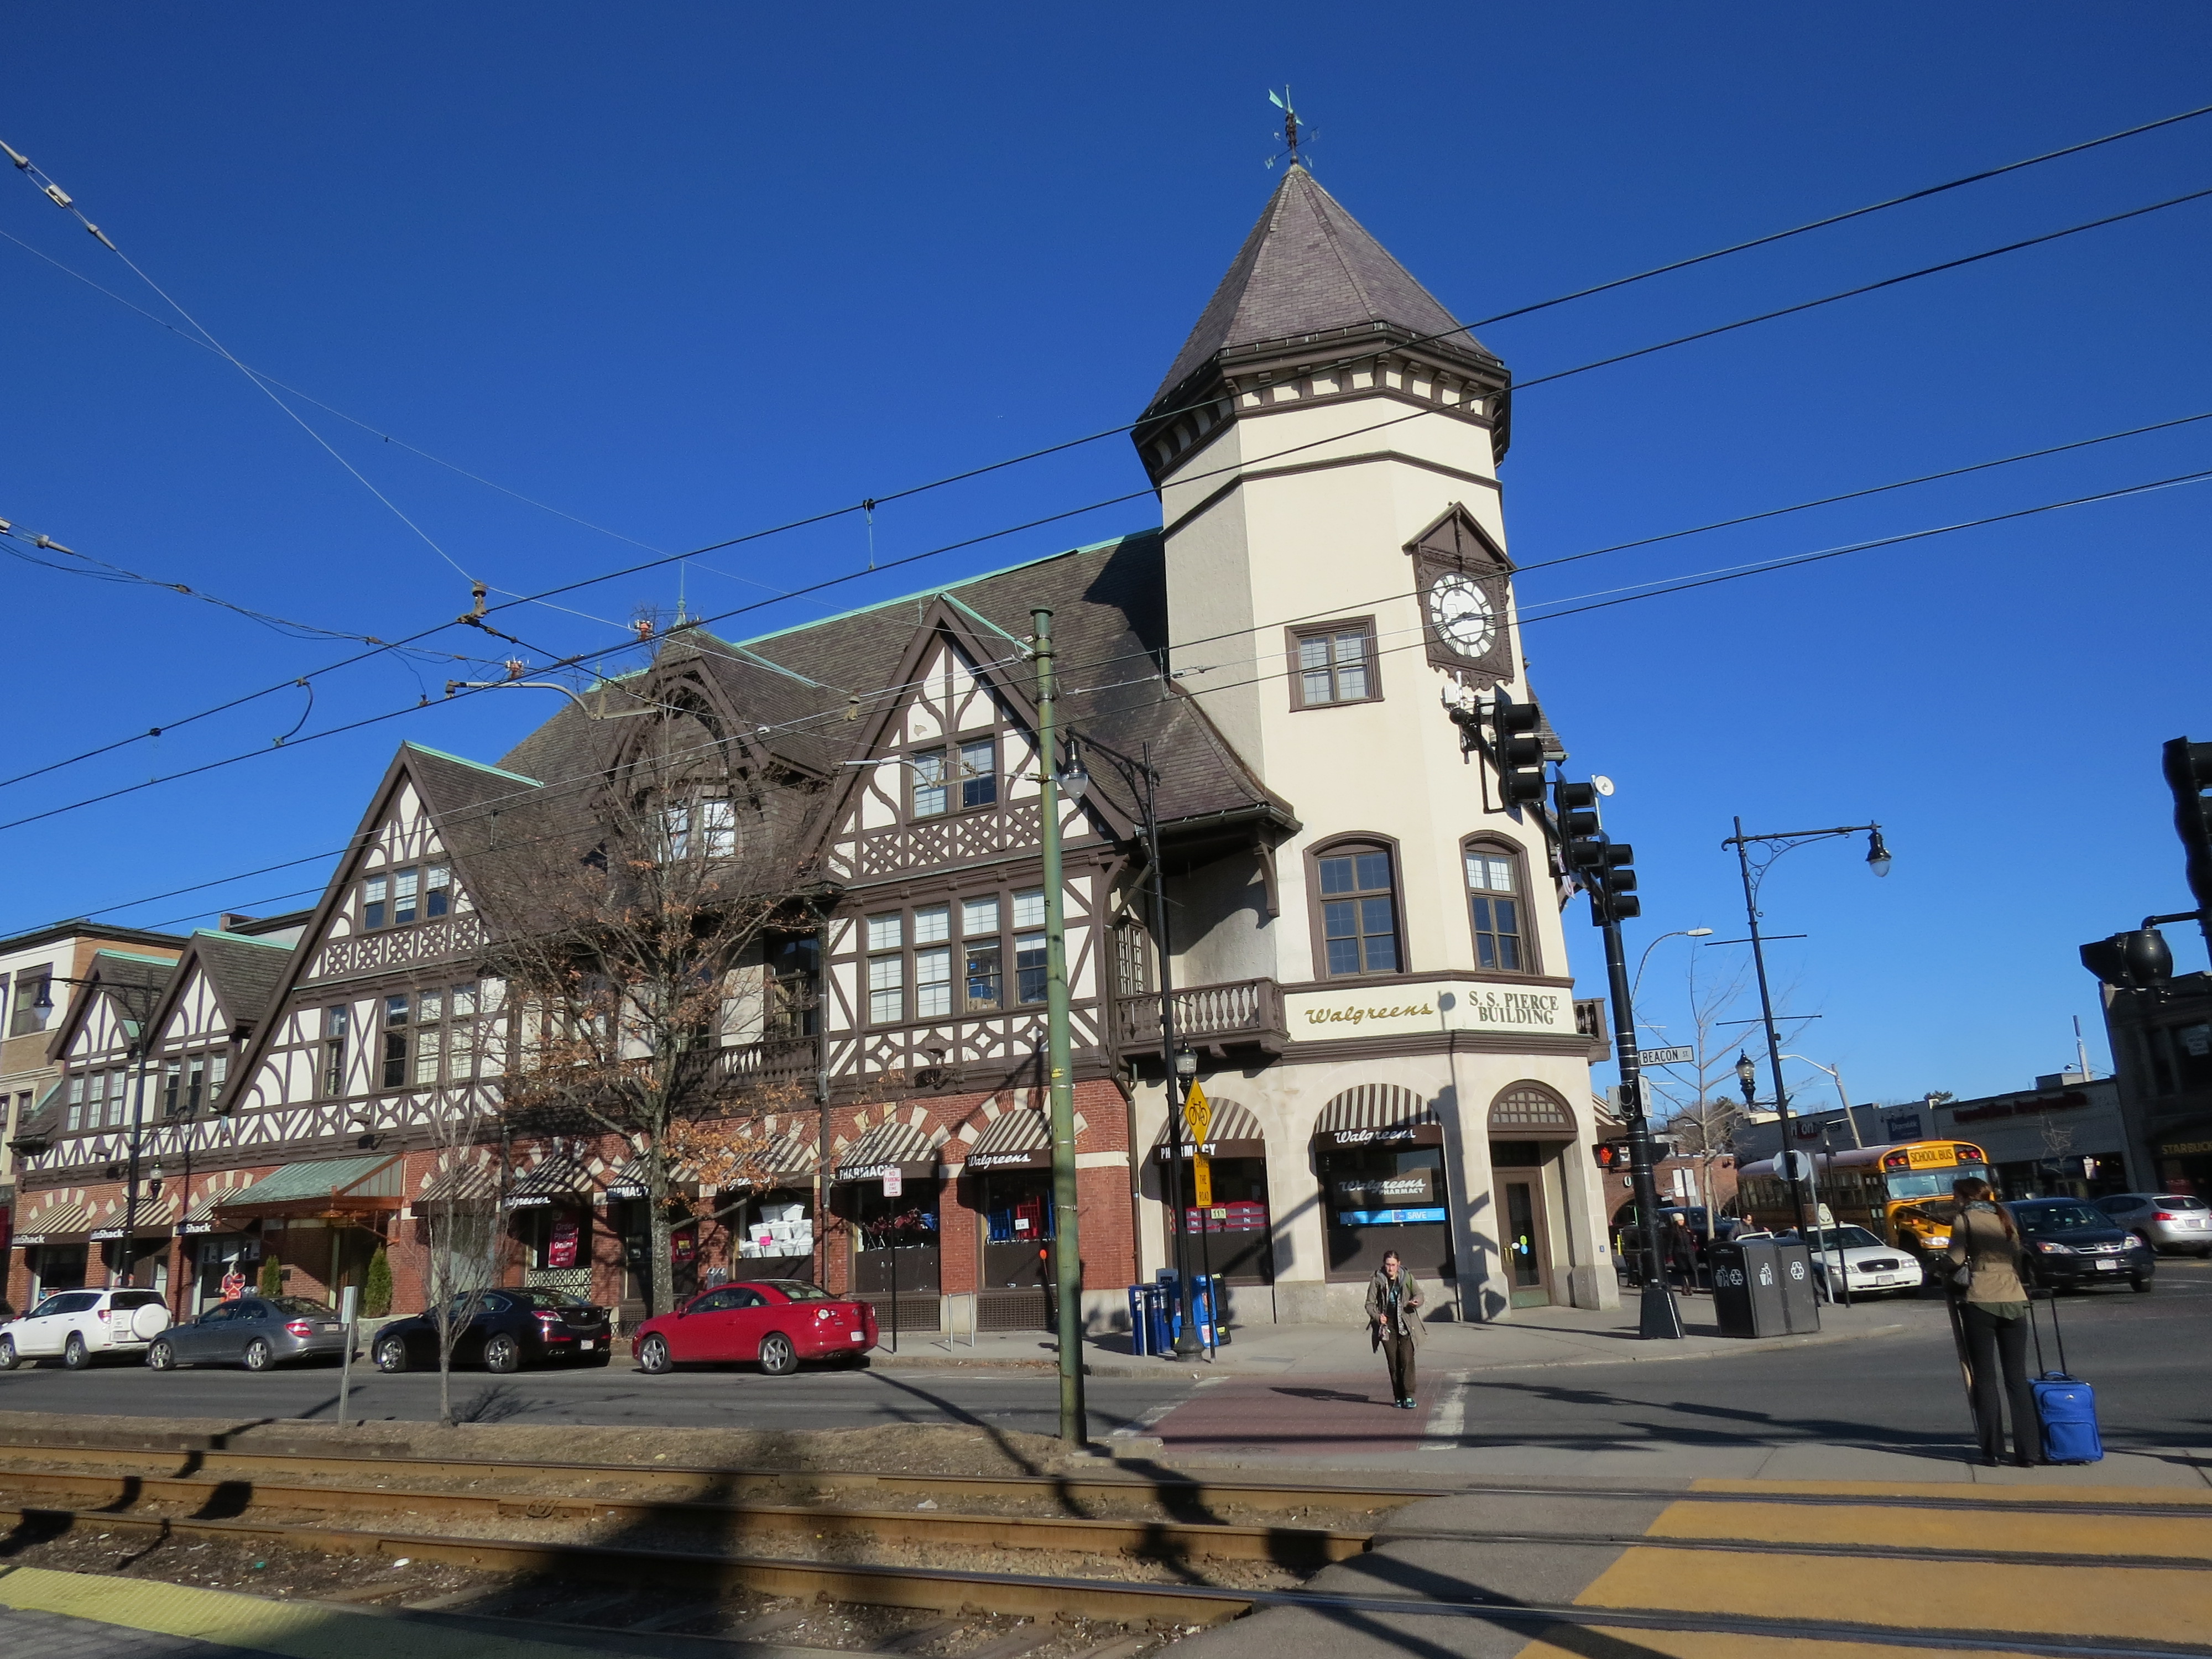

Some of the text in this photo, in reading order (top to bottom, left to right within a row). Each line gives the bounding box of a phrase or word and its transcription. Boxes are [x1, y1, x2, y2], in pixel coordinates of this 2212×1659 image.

[1469, 990, 1559, 1010] S. S. PIERCE
[1305, 1003, 1434, 1025] Walgreens
[1477, 1006, 1554, 1025] BUILDING
[1642, 1049, 1678, 1063] BEACON
[1333, 1129, 1416, 1145] Walgreens
[1910, 1149, 1954, 1162] SCHOOL BUS
[2161, 1141, 2212, 1155] STARBUCK
[967, 1153, 1032, 1170] Walgreens
[1338, 1178, 1426, 1194] Walgreens
[1198, 1191, 1209, 1201] ROAD
[1407, 1211, 1427, 1219] SAVE
[555, 1241, 573, 1249] Online
